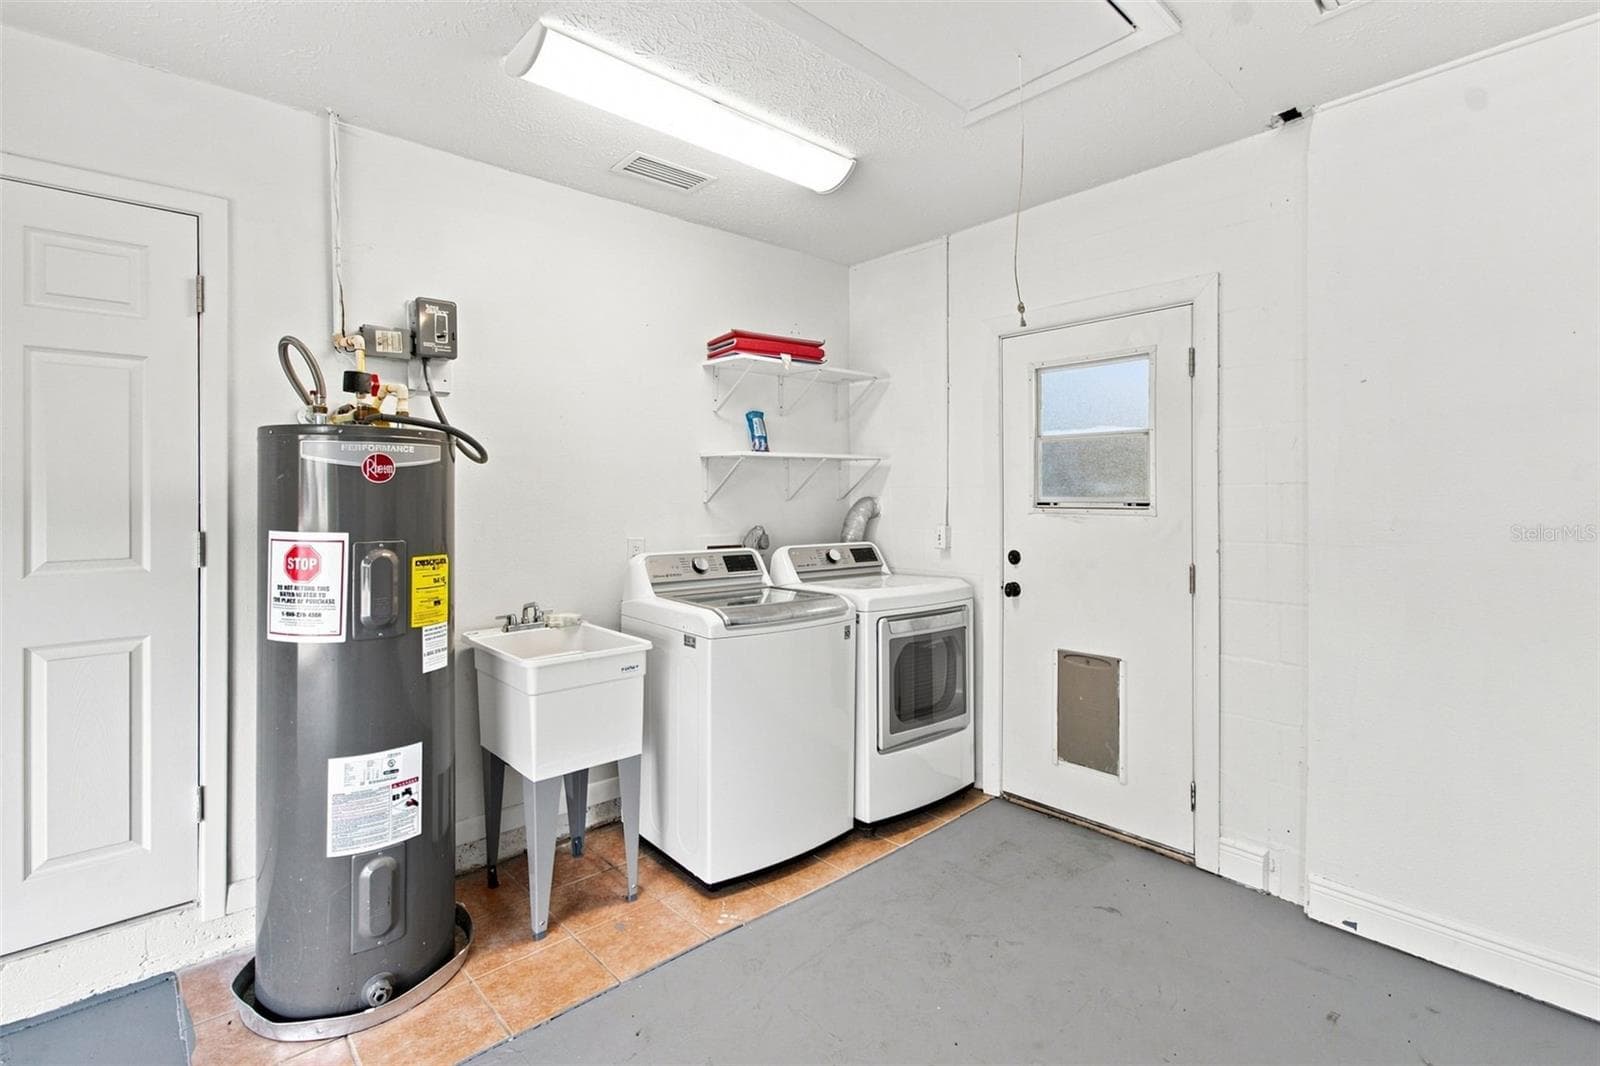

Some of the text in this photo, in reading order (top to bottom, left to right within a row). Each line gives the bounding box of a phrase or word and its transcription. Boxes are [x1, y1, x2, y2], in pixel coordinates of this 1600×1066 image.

[340, 443, 415, 453] PERFORMANCE
[366, 455, 393, 477] Rheem
[287, 557, 318, 570] STOP
